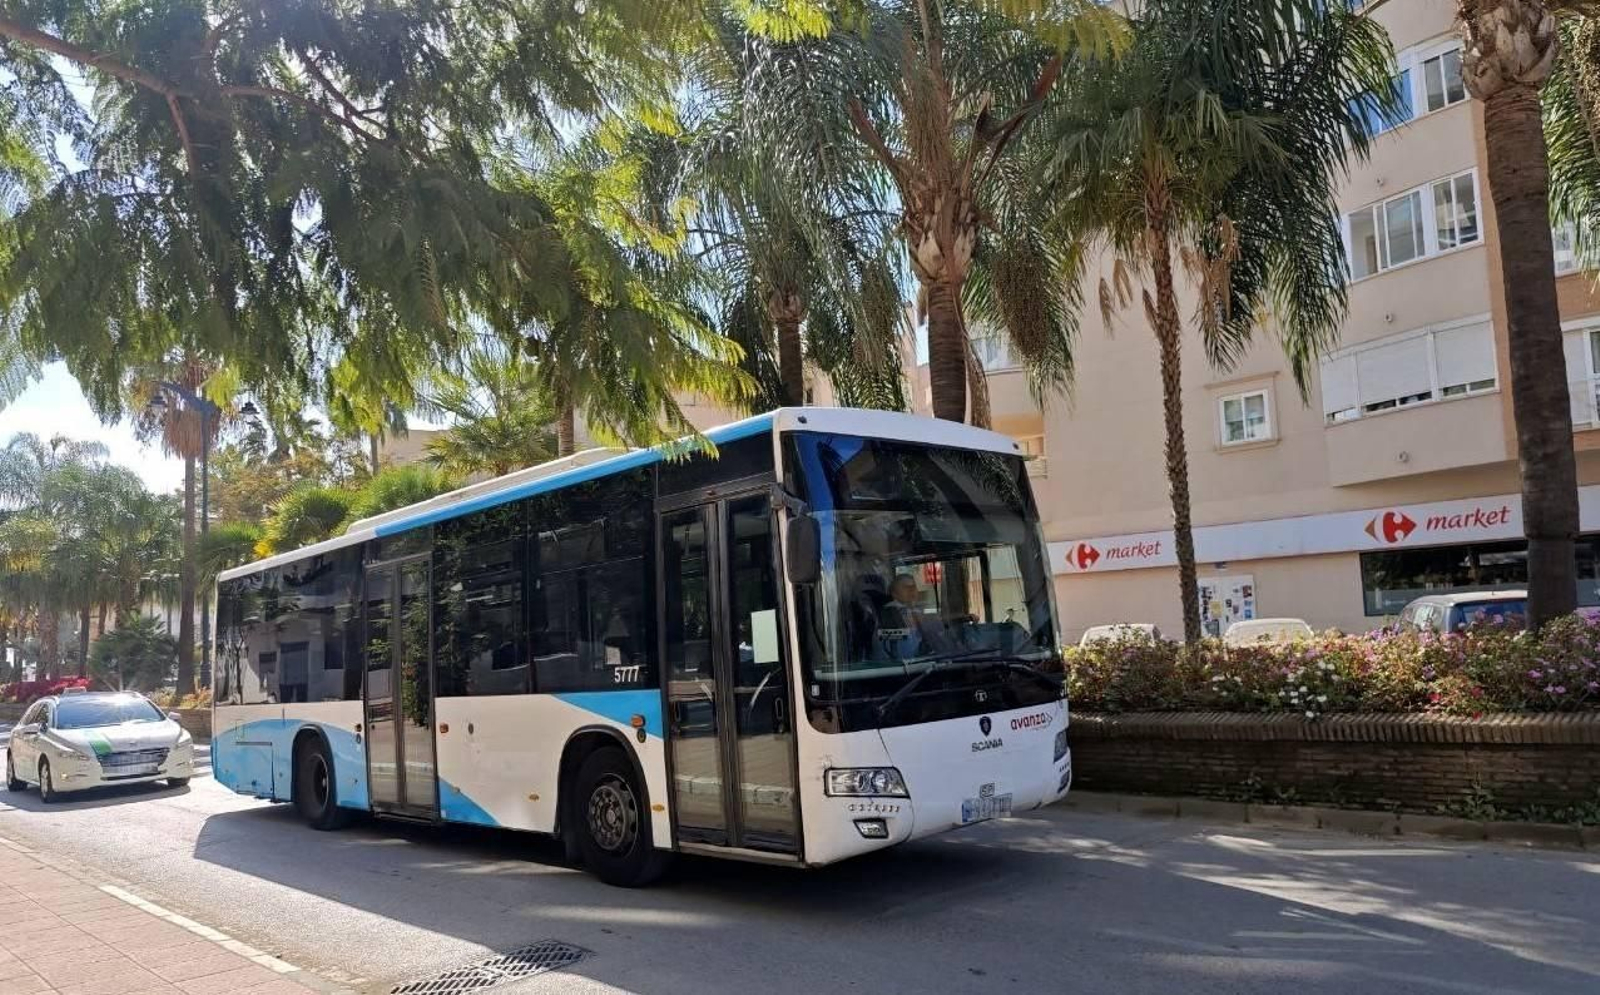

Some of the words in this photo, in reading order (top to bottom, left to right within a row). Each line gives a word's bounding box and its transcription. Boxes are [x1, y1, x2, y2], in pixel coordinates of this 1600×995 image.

[1426, 506, 1512, 531] market
[1106, 541, 1162, 559] market
[614, 665, 640, 683] 5777
[1010, 712, 1047, 731] avanza
[971, 738, 1003, 752] SCANIA
